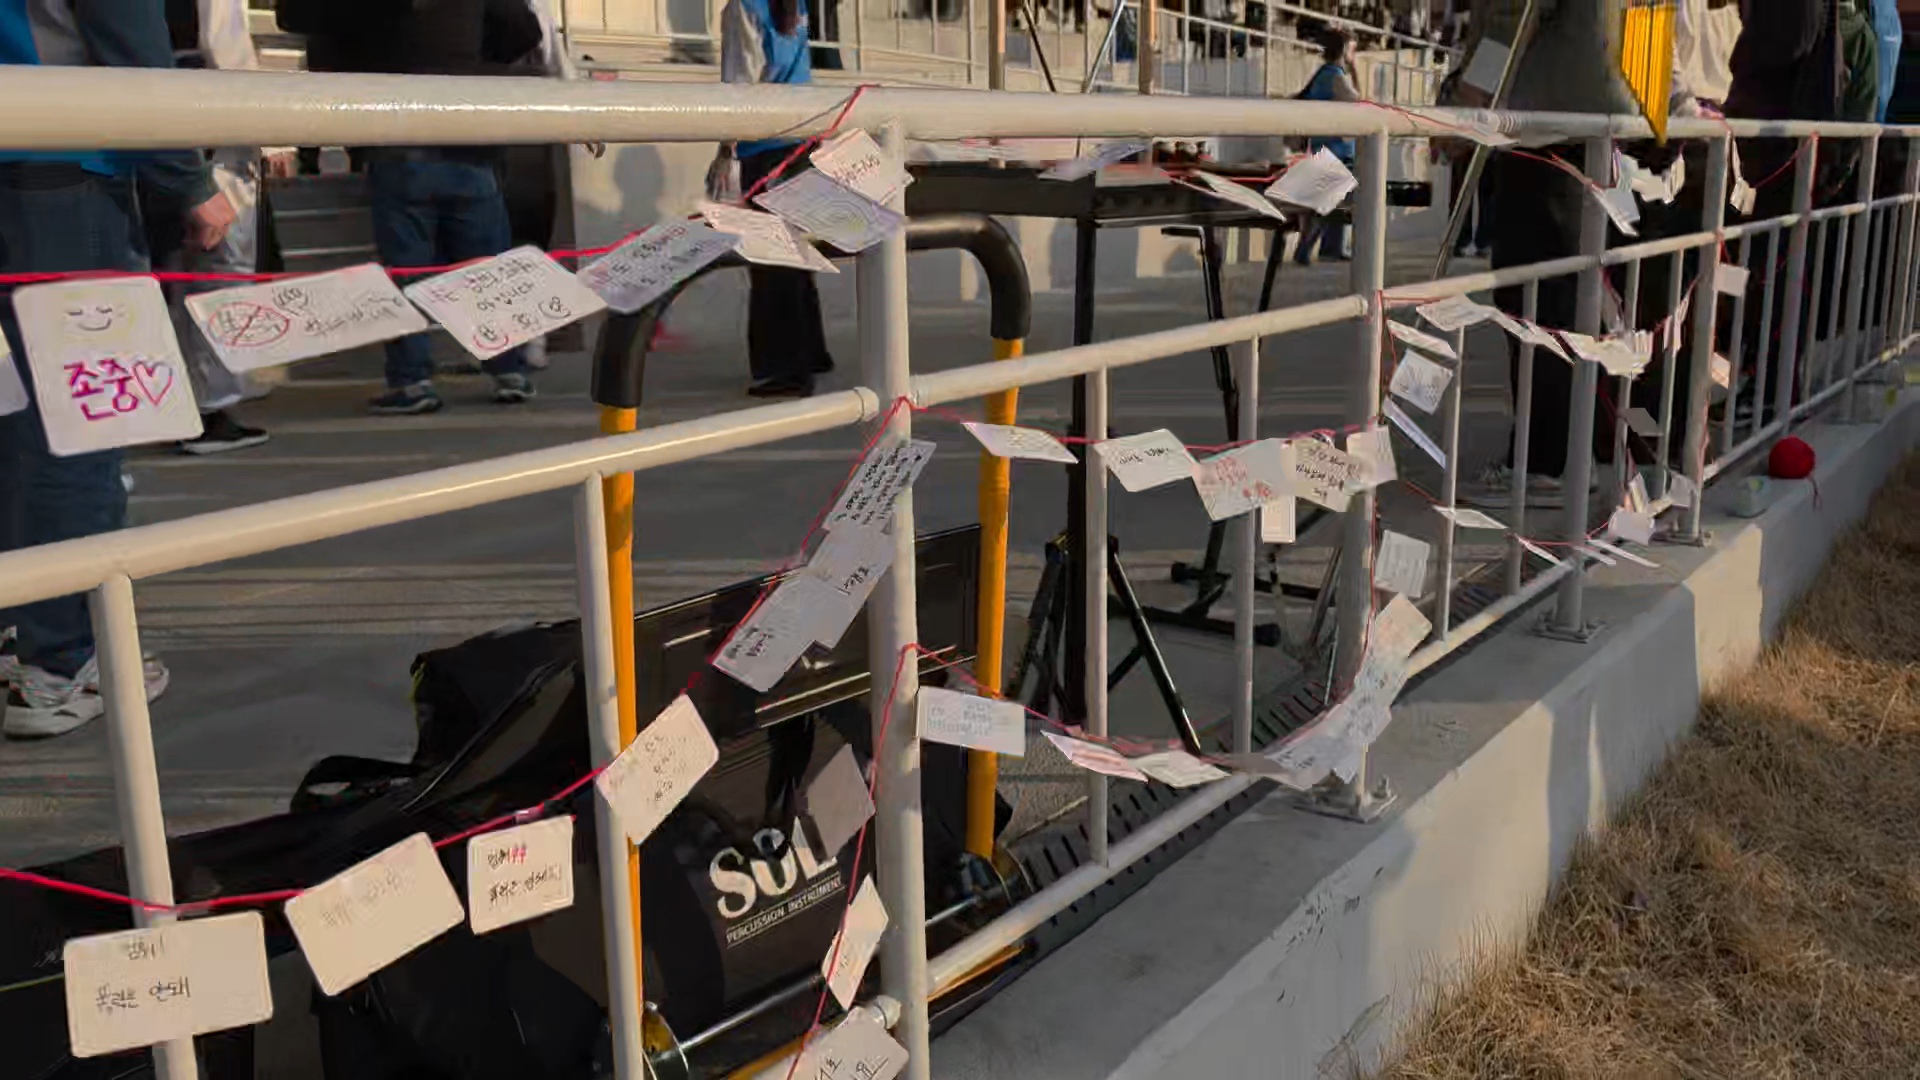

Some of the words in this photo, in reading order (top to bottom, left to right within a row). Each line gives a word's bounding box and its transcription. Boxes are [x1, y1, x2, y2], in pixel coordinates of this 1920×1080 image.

[64, 358, 138, 421] 존중
[726, 908, 786, 943] PERCUSSION
[788, 875, 842, 912] INSTRUMENT
